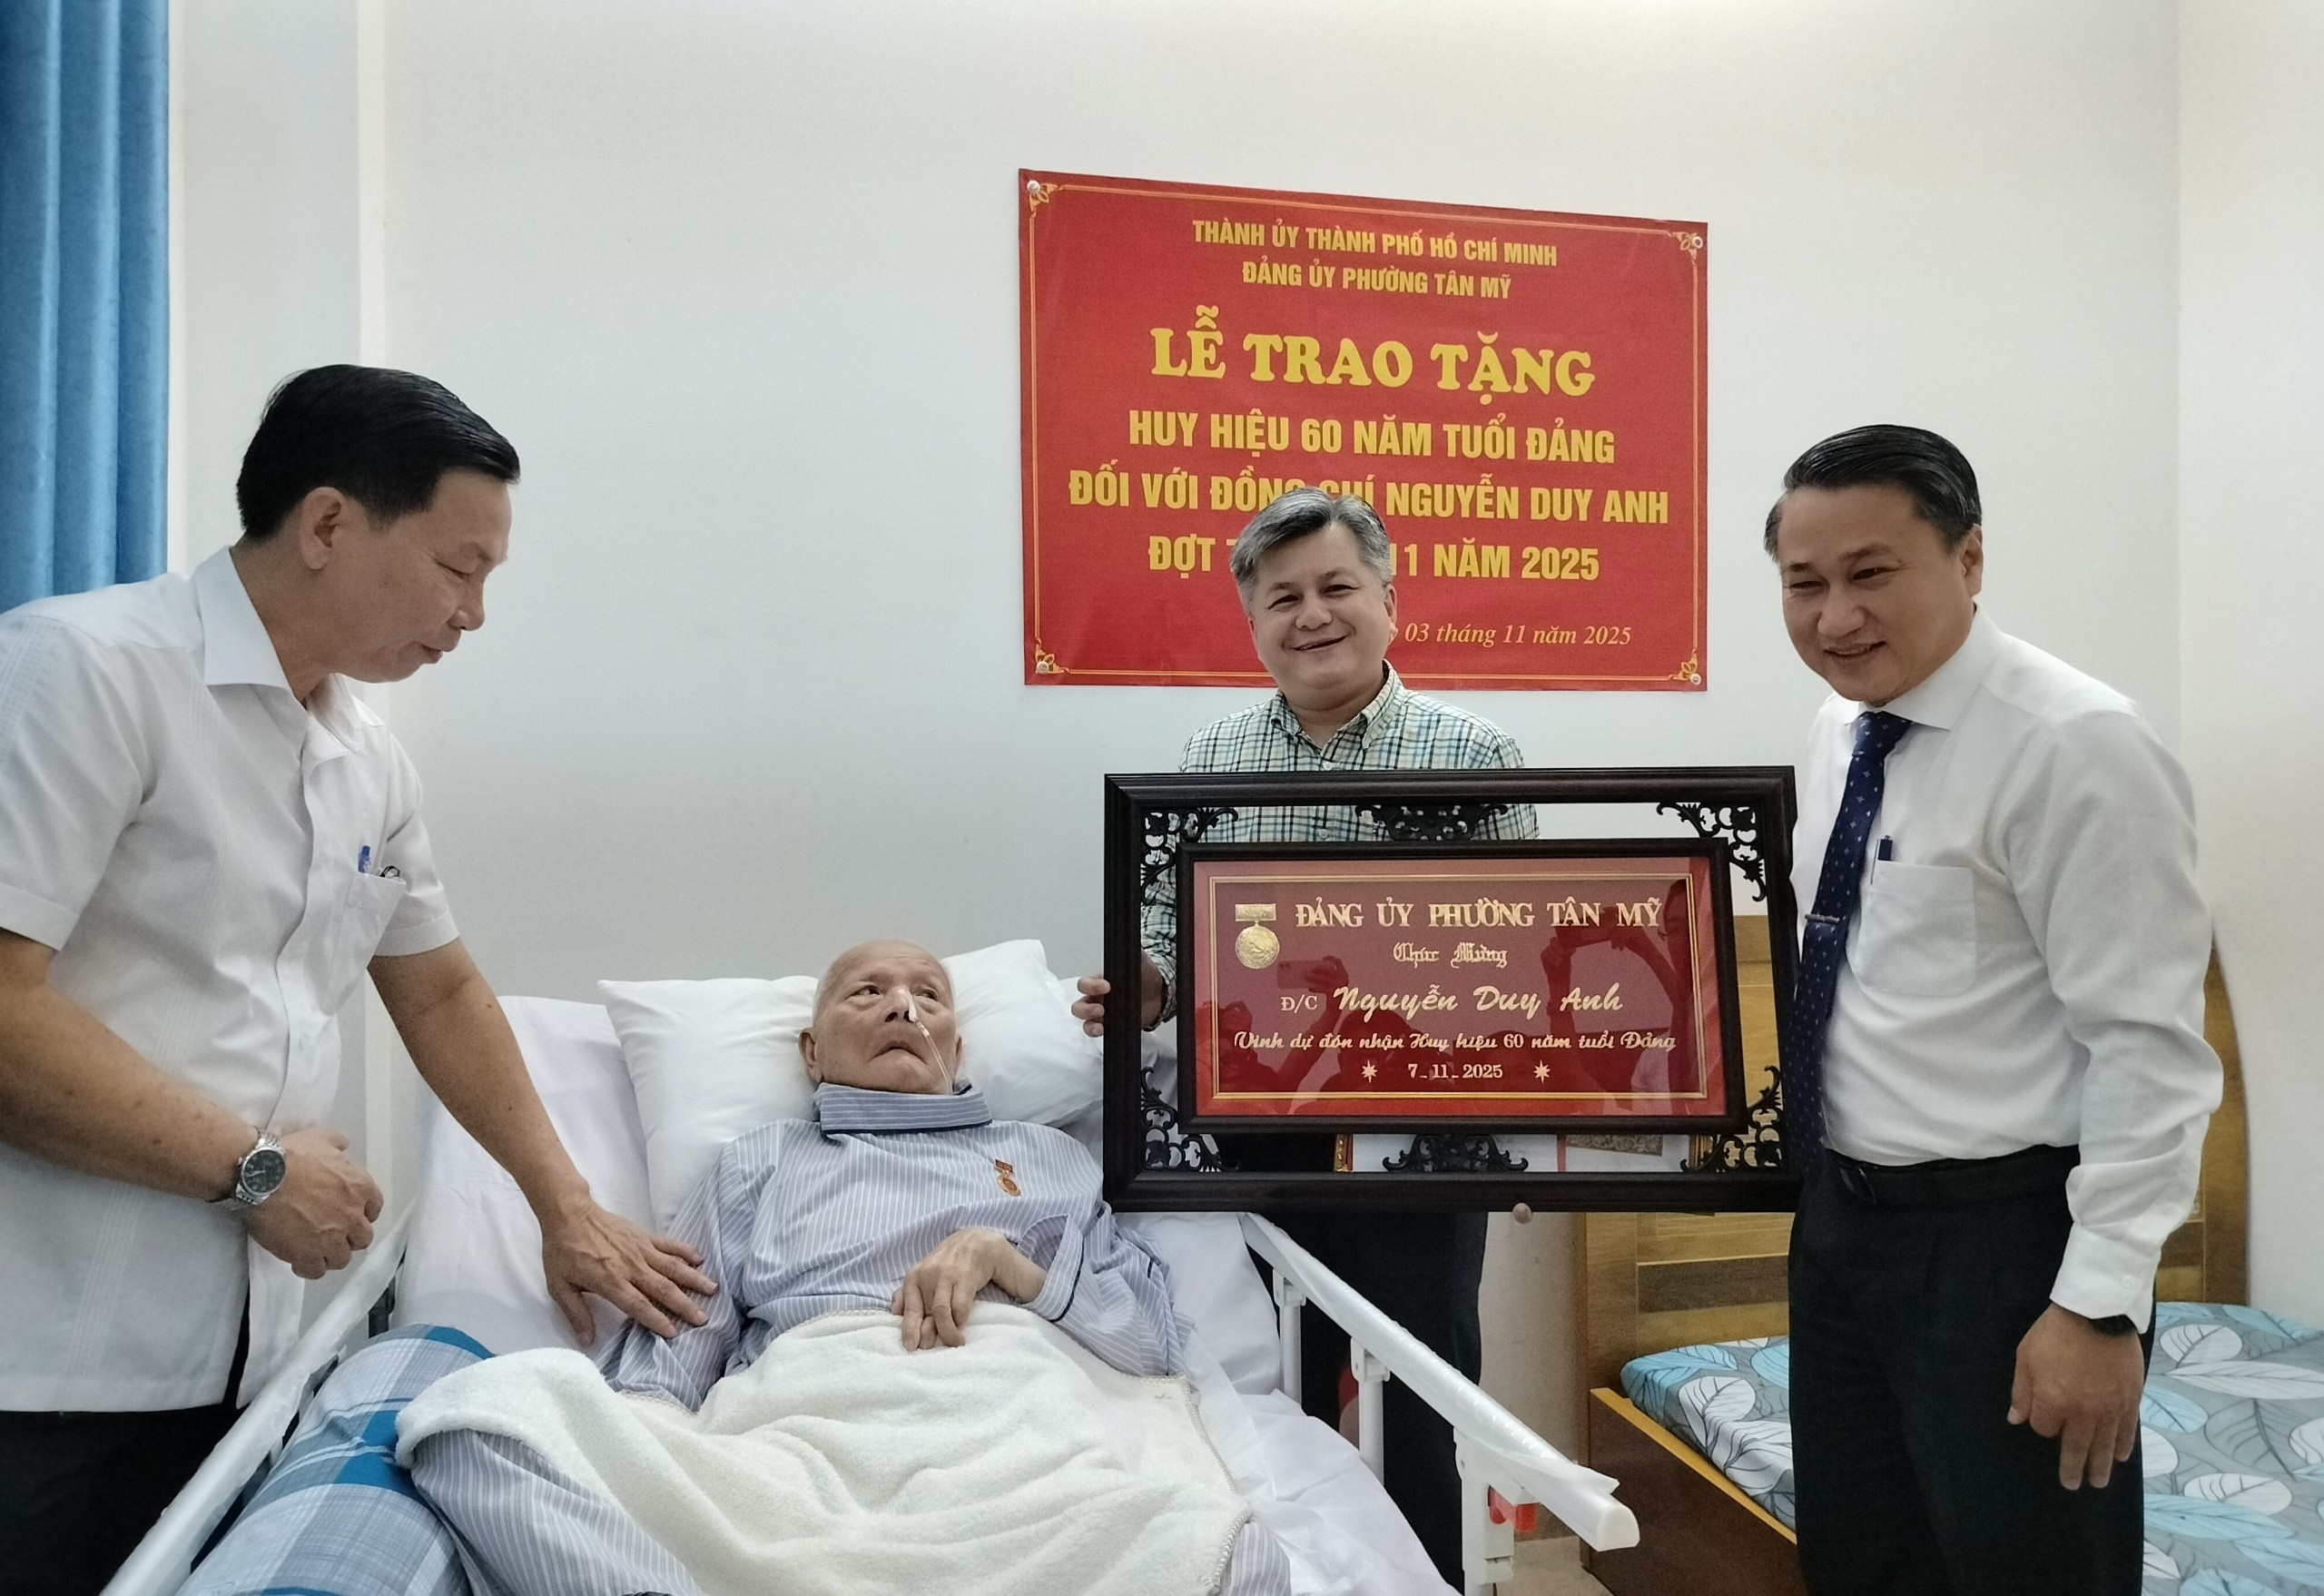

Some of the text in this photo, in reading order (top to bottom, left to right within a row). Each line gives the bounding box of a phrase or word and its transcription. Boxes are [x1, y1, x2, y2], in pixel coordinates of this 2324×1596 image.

[1192, 217, 1557, 267] THÀNH ỦY THÀNH PHỐ HỒ CHÍ MINH
[1242, 255, 1512, 300] ĐẢNG ỦY PHƯỜNG TÂN MỸ
[1150, 304, 1596, 406] LỄ TRAO TẶNG
[1129, 408, 1615, 464] HUY HIỆU 60 NĂM TUỔI ĐẢNG
[1068, 458, 1129, 507] ĐỐI
[1141, 467, 1198, 509] VỚI
[1385, 473, 1520, 519] NGUYỄN
[1530, 487, 1593, 522] DUY
[1602, 489, 1669, 524] ANH
[1147, 533, 1216, 579] ĐỢT
[1433, 537, 1511, 578] NĂM
[1521, 546, 1600, 581] 2025
[1404, 622, 1631, 648] 03 tháng 11 năm 2025
[1295, 895, 1663, 928] ĐẢNG ỦY PHƯỜNG TÂN MỸ
[1280, 981, 1624, 1023] Đ/C Nguyễn Duy Anh
[1289, 1032, 1315, 1050] dự
[1318, 1032, 1354, 1049] đón
[1359, 1032, 1404, 1051] nhận
[1409, 1032, 1451, 1052] Huy
[1455, 1032, 1498, 1051] hiệu
[1503, 1033, 1524, 1049] 60
[1531, 1033, 1572, 1049] năm
[1578, 1030, 1615, 1049] tuổi
[1620, 1031, 1677, 1053] Đảng
